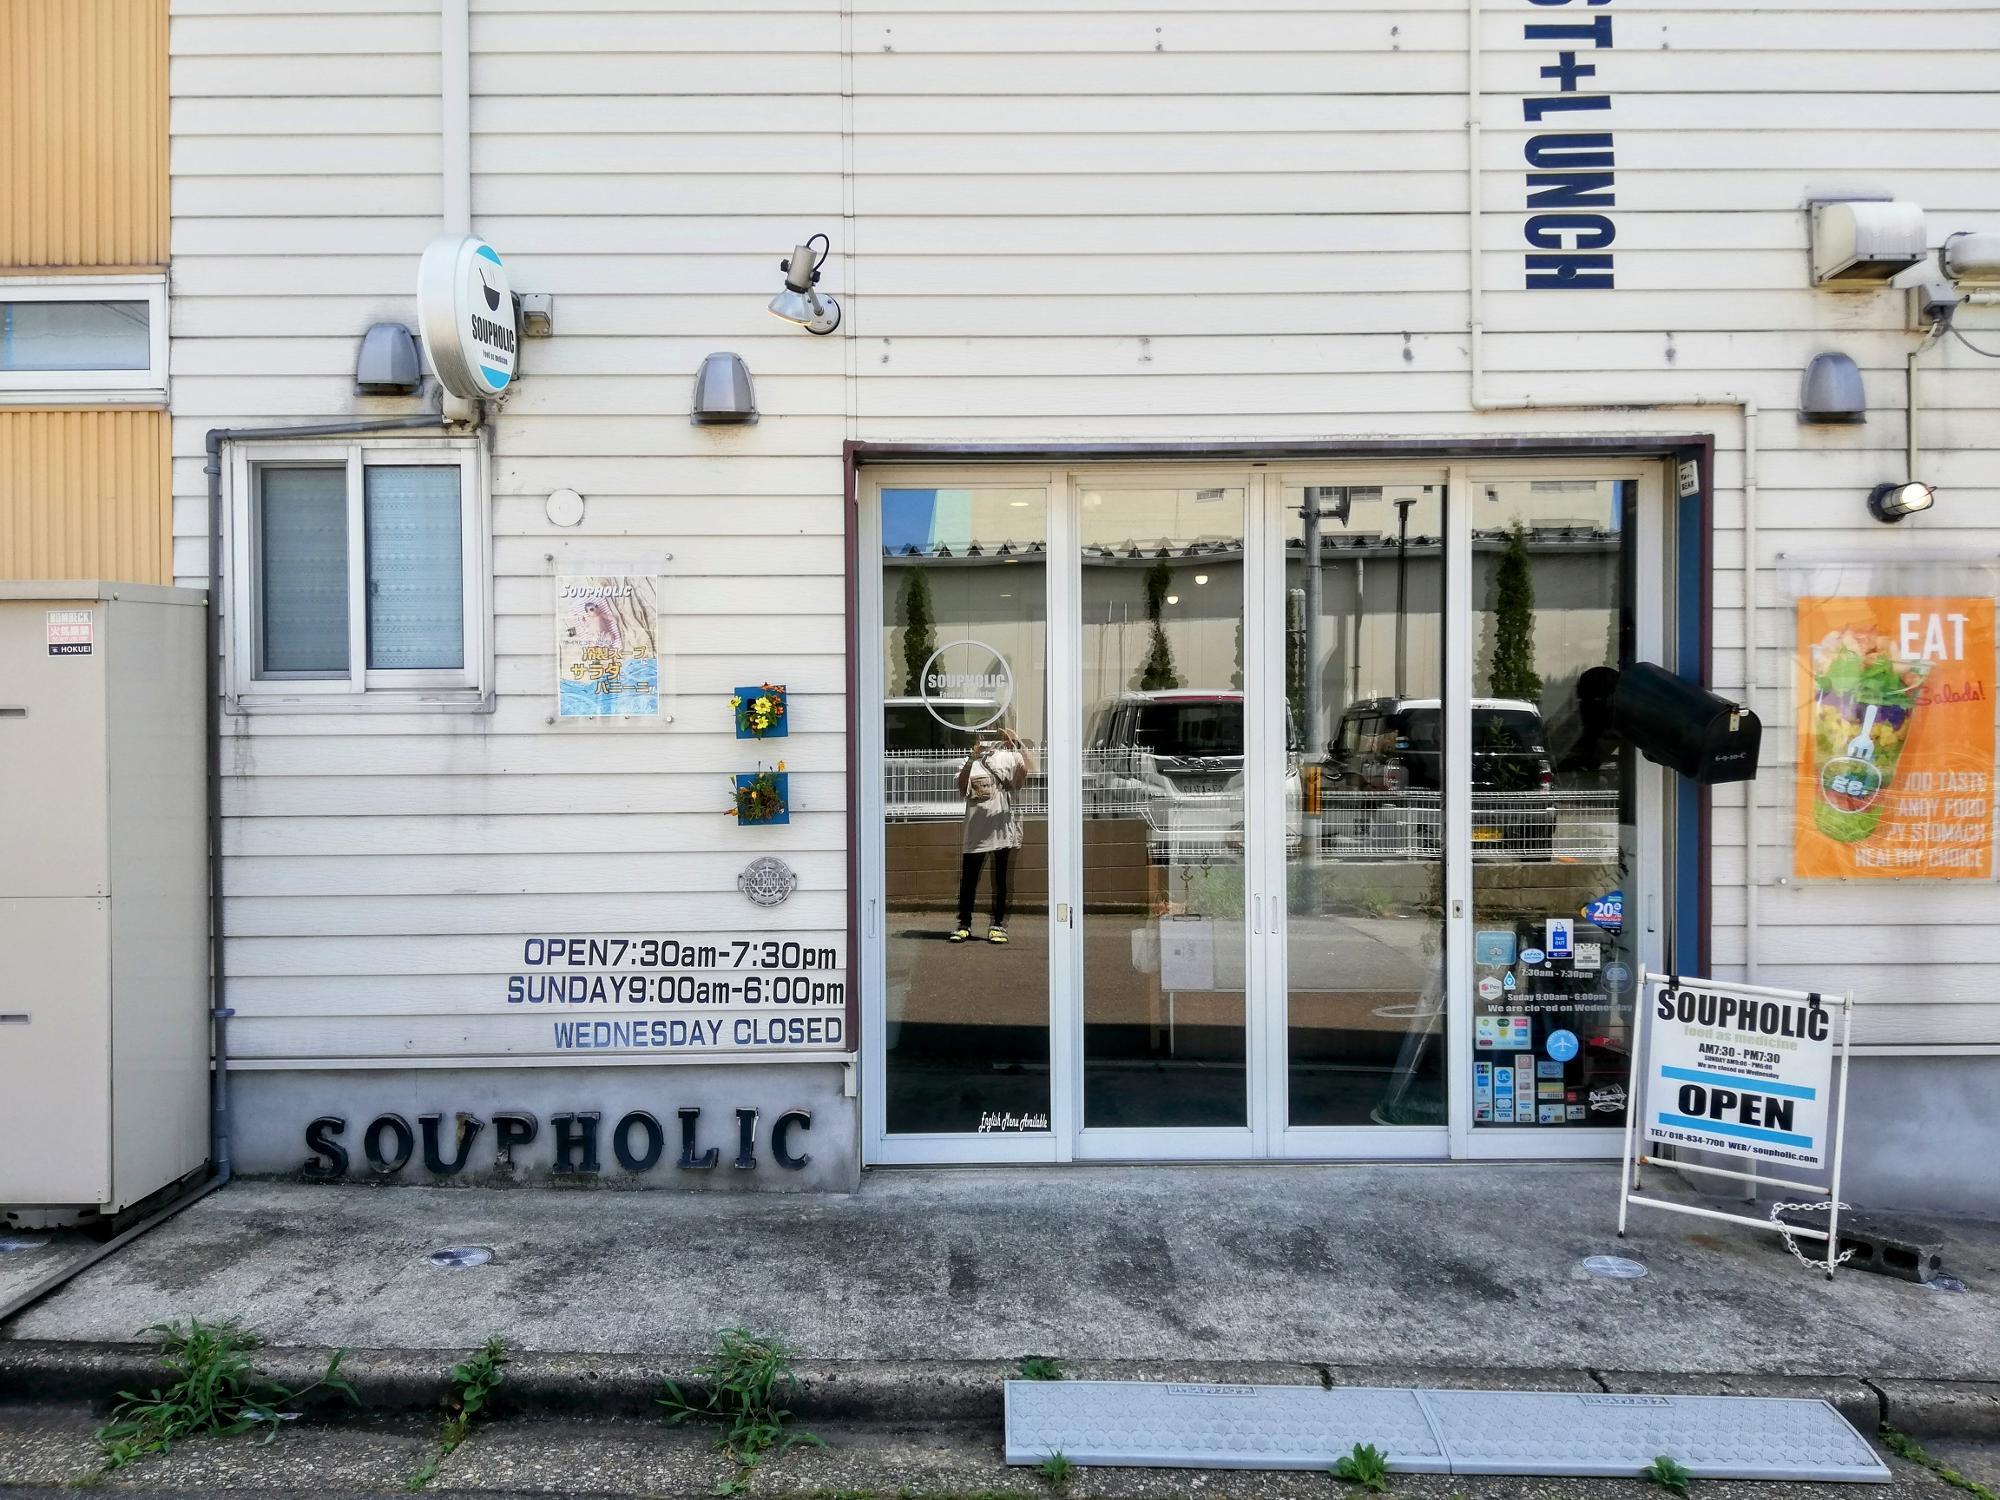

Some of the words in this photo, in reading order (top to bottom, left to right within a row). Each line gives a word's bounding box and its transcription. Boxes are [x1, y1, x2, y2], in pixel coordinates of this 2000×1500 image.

[1522, 0, 1616, 290] T+LUNCH
[472, 313, 515, 354] SOUPHOLIC
[560, 585, 633, 598] SOUPHOLIC
[61, 645, 91, 653] HOKUEI
[1900, 613, 1965, 661] EAT
[928, 674, 1008, 688] SOUPHOLIC
[1521, 968, 1554, 977] 7:30am
[1561, 969, 1594, 979] 7:30pm
[1487, 1004, 1504, 1012] We
[1535, 993, 1568, 1001] 9:00am
[1657, 989, 1830, 1042] SOUPHOLIC
[554, 1020, 724, 1049] WEDNESDAY
[733, 1017, 843, 1045] CLOSED
[1684, 1025, 1714, 1039] food
[1716, 1030, 1732, 1042] as
[1735, 1033, 1799, 1051] medicine
[1698, 1042, 1736, 1058] AM7:30
[1743, 1048, 1781, 1064] PM7:30
[1746, 1069, 1780, 1080] Wednesday
[1677, 1083, 1795, 1133] OPEN
[978, 1111, 1001, 1133] English
[1001, 1112, 1019, 1131] Menu
[1020, 1112, 1047, 1132] Available
[303, 1107, 814, 1179] SOUPHOLIC
[1650, 1128, 1668, 1139] TEL/
[1669, 1131, 1726, 1148] 018-834-7700
[1728, 1141, 1752, 1152] WEB/
[1752, 1146, 1819, 1164] soupholic.com
